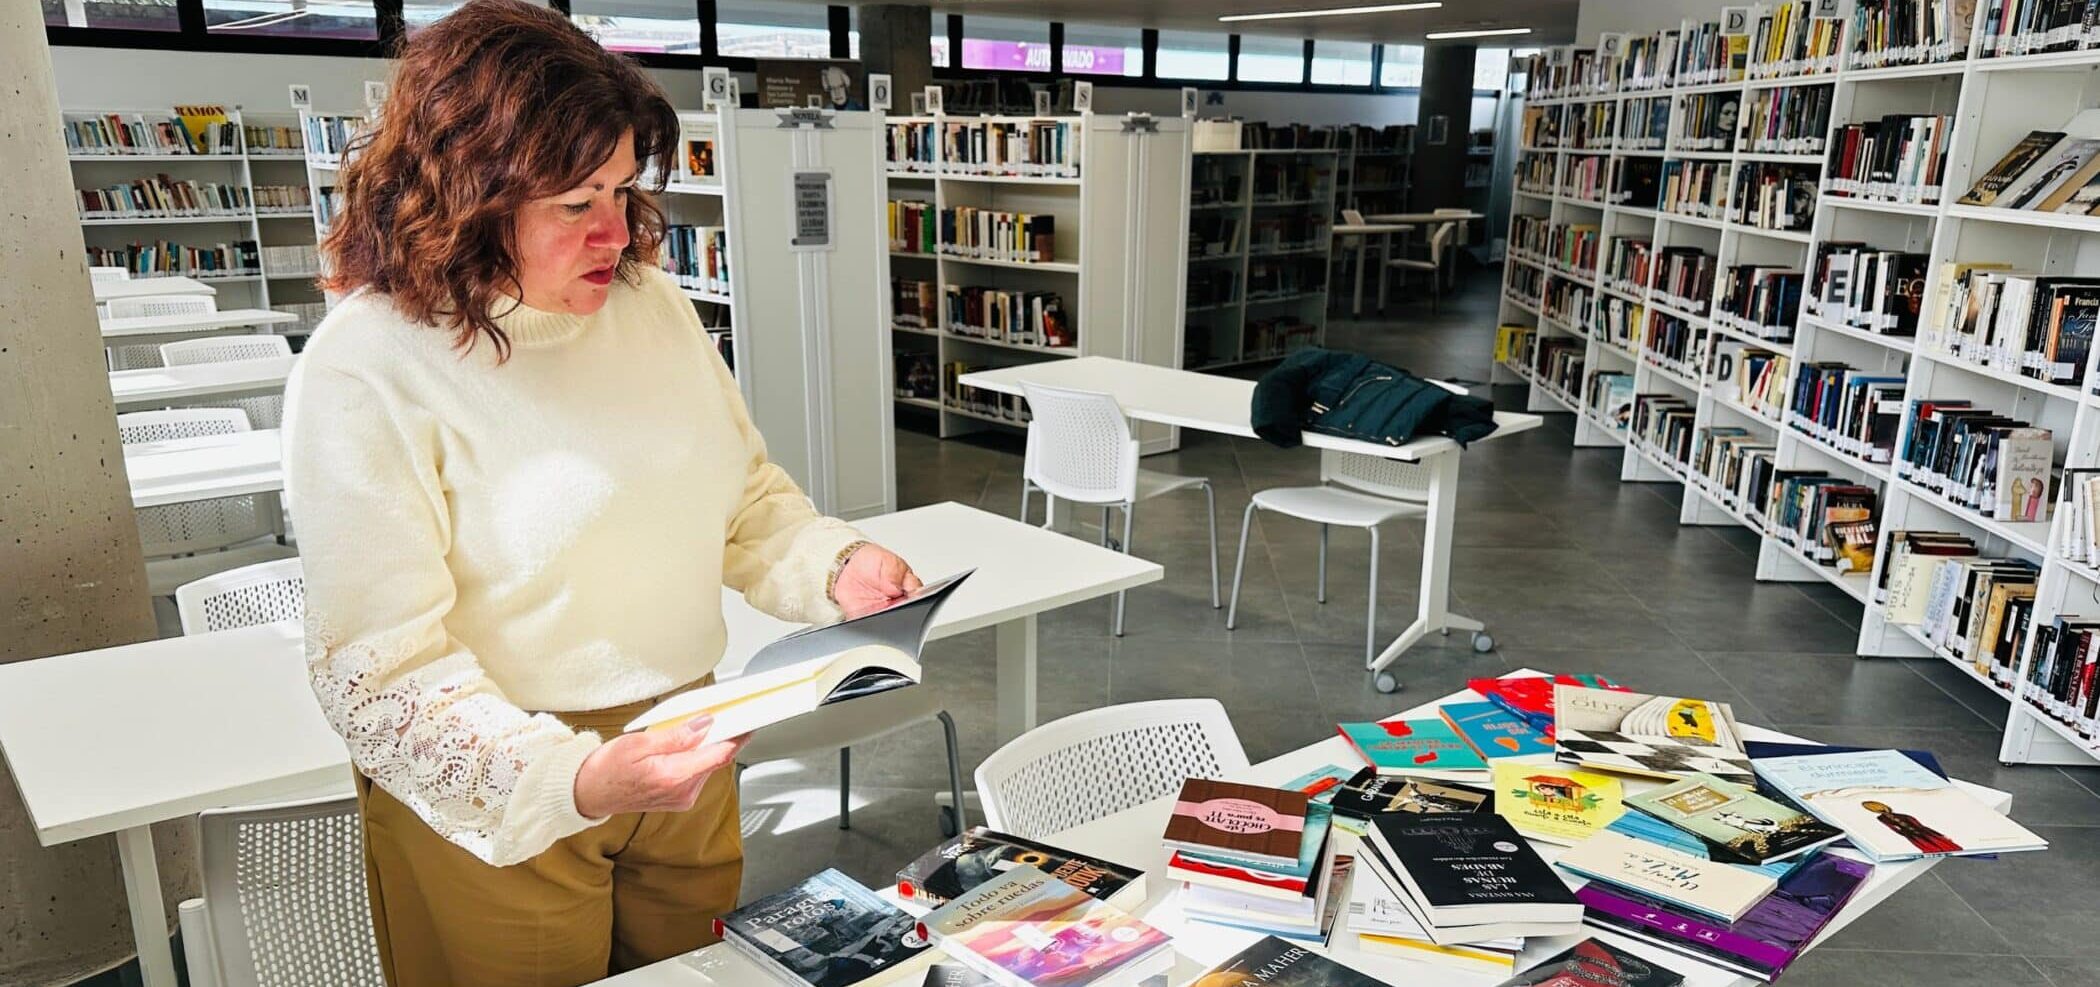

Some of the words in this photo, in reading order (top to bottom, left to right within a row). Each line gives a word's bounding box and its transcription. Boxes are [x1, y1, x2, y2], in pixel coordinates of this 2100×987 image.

[1728, 13, 1744, 29] D
[1605, 38, 1617, 51] C
[293, 89, 308, 102] M
[710, 77, 724, 94] G
[875, 82, 887, 99] O
[1827, 270, 1848, 303] E
[1718, 353, 1733, 382] D
[954, 904, 997, 929] sobre
[997, 878, 1046, 907] ruedas
[955, 888, 999, 913] Todo
[997, 880, 1019, 895] va
[781, 900, 837, 930] rotos
